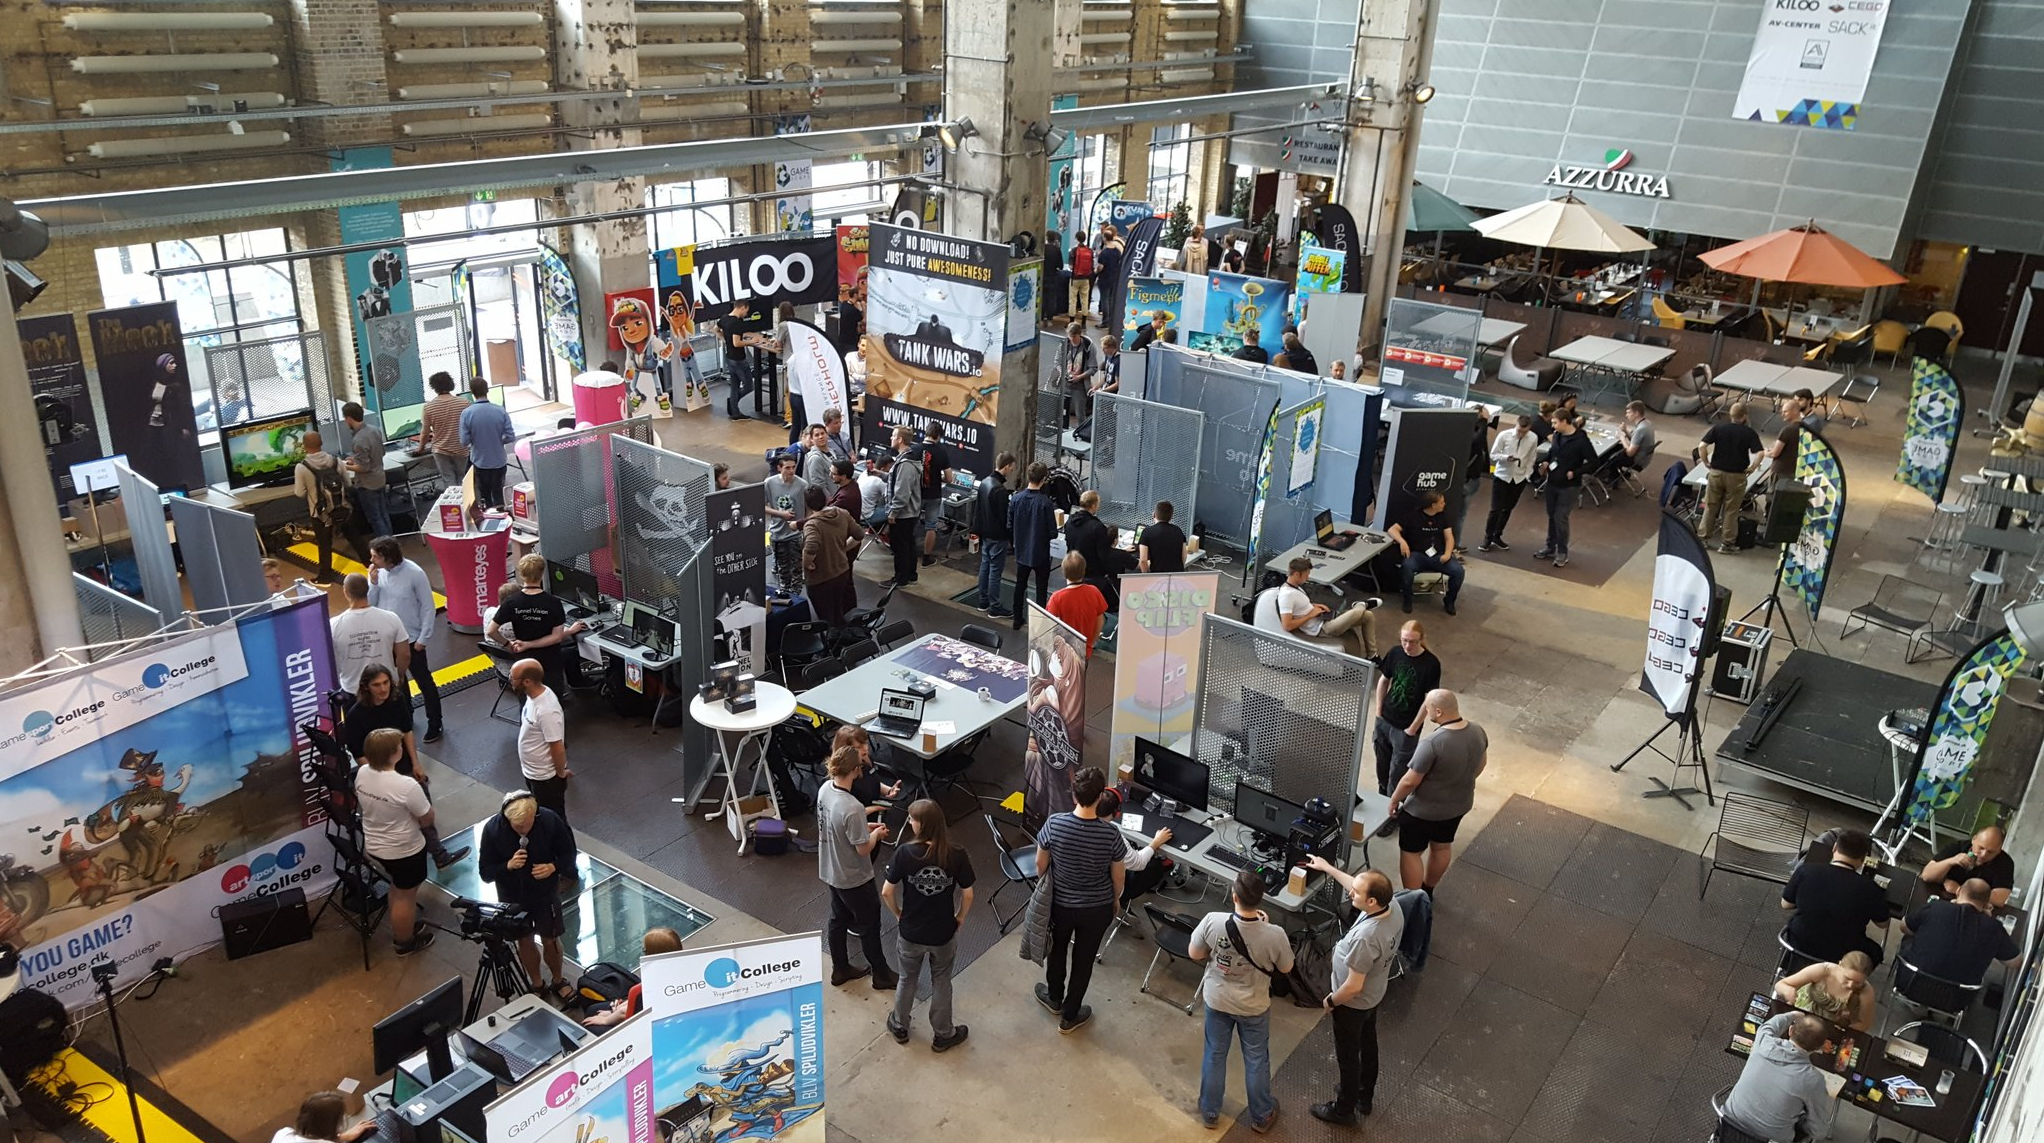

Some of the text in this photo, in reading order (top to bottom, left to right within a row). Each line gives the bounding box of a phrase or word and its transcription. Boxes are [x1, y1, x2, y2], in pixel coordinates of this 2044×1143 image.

[1775, 0, 1820, 11] KILOO
[1768, 20, 1821, 29] AV-CENTER
[1828, 20, 1867, 35] SACK
[1294, 140, 1340, 151] RESTAURAN
[1299, 154, 1338, 166] TAKE AWA
[1543, 164, 1670, 198] AZZURRA
[906, 234, 970, 260] NO DOWNLOAD!
[1332, 221, 1347, 250] SAC
[692, 252, 814, 305] KILOO
[884, 250, 992, 282] JUST PURE AWESOMENESS!
[898, 339, 930, 365] TANK
[882, 406, 977, 445] WWW.TANARS.IO
[1416, 478, 1437, 488] hub
[1418, 472, 1448, 481] game
[714, 554, 725, 566] SEE
[725, 551, 735, 562] YOU
[727, 562, 745, 575] OTHER
[476, 544, 488, 619] smarteyes
[112, 683, 145, 703] Game
[170, 654, 216, 679] College
[0, 731, 26, 751] ame
[55, 698, 106, 726] College
[256, 864, 322, 898] College
[21, 913, 134, 979] YOU GAME?
[663, 980, 707, 997] Game
[740, 958, 801, 980] College
[800, 1002, 818, 1100] BLIV SPILUDVIKLER
[508, 1105, 548, 1139] Game
[579, 1043, 634, 1086] College
[634, 1079, 648, 1143] PILUDVIKLER
